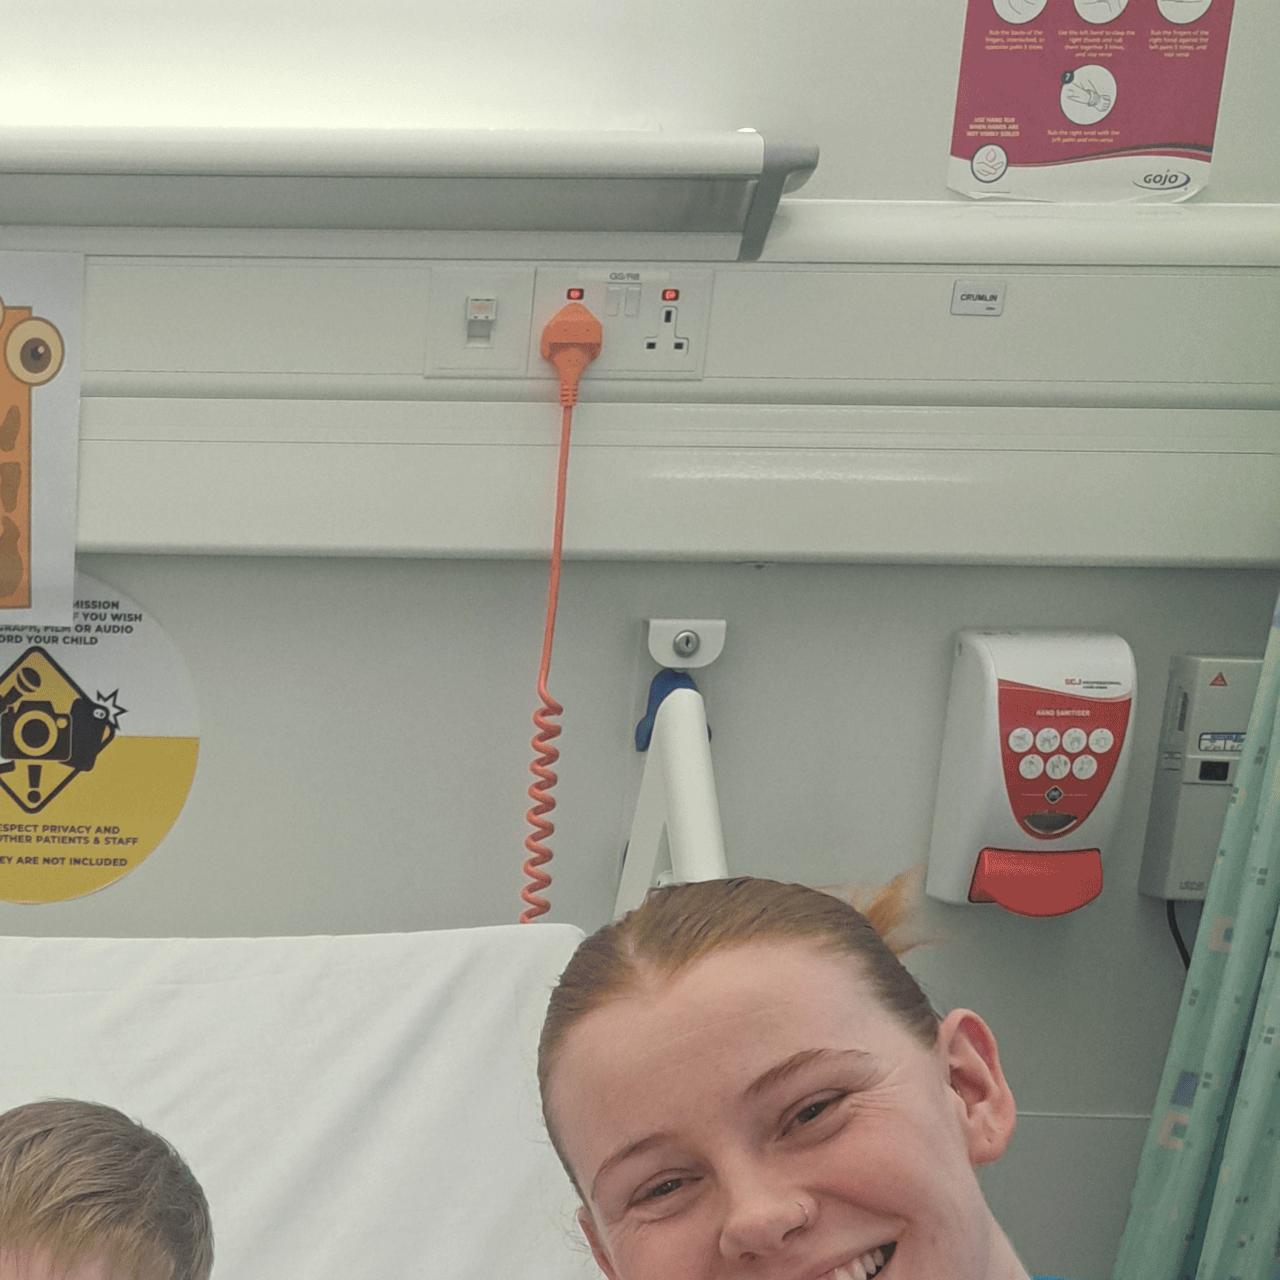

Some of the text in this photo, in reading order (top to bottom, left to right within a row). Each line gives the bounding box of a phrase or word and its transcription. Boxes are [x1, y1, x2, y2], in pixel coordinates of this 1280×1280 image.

[960, 293, 998, 302] CRUMLIN
[82, 612, 106, 621] YOU
[111, 613, 143, 622] WISH
[74, 624, 91, 633] OR
[95, 625, 134, 634] AUDIO
[26, 635, 58, 644] YOUR
[62, 635, 98, 645] CHILD
[42, 824, 92, 834] PRIVACY
[95, 825, 120, 834] AND
[36, 835, 90, 845] PATIENTS
[93, 836, 100, 845] &
[104, 836, 138, 845] STAFF
[16, 856, 39, 865] ARE
[42, 856, 66, 866] NOT
[69, 857, 128, 866] INCLUDED
